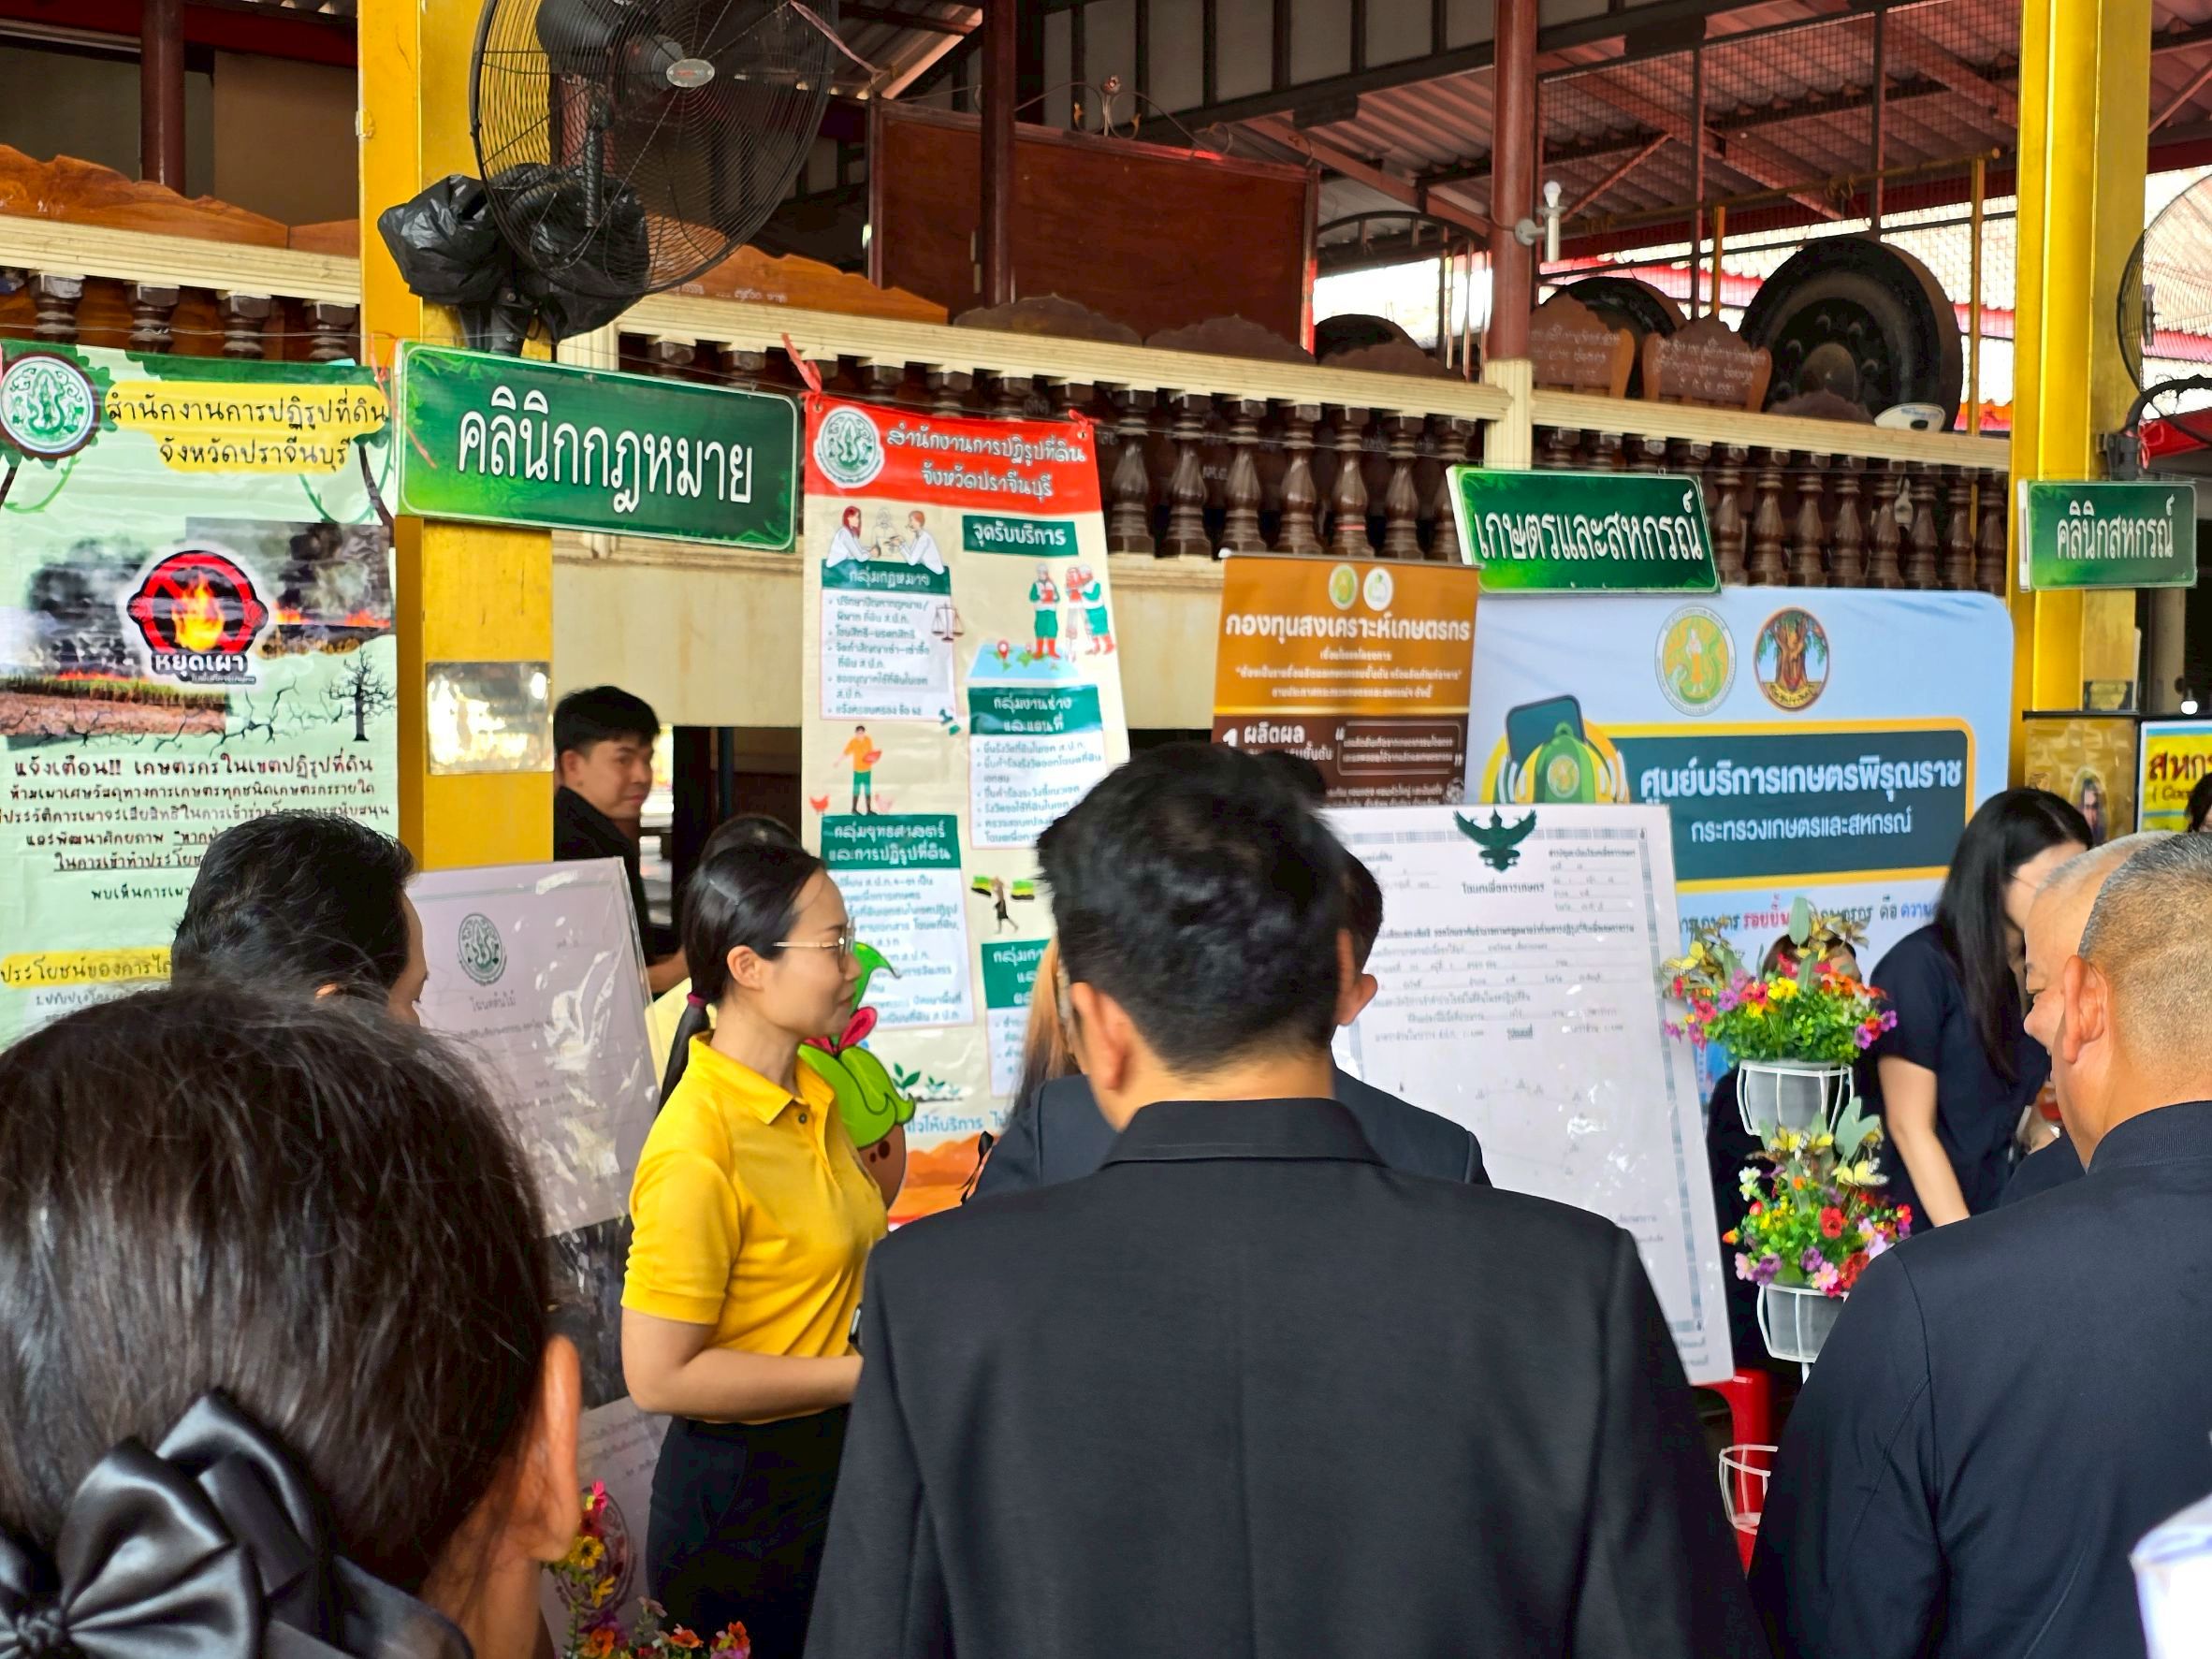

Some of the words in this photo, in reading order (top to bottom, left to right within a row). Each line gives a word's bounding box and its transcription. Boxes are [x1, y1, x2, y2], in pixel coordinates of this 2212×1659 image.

[107, 388, 387, 429] สำนักงานการปฏิรูปที่ดิน
[159, 437, 349, 471] จังหวัดปราจีนบุรี
[458, 385, 753, 514] คลินิกกฎหมาย
[887, 421, 1086, 466] สำนักงานการปฏิรูปที่ดิน
[922, 461, 1054, 502] จังหวัดปราจีนบุรี
[973, 519, 1067, 547] จุดรับบริการ
[1474, 488, 1705, 560] เกษตรและสหกรณ์
[2057, 494, 2176, 560] คลินิกสหกรณ์
[850, 565, 931, 589] กลุ่มกฎหมาย
[1226, 612, 1470, 644] กองทุนสงเคราะห์เกษตรกร
[154, 653, 245, 677] หยุดเผา
[1244, 721, 1305, 744] ผลิตผล
[15, 754, 122, 777] แจ้งเตือน!!
[1640, 755, 1961, 804] ศูนย์บริการเกษตรพิรุณราช
[1691, 806, 1912, 842] กระทรวงเกษตรและสหกรณ์
[1880, 895, 1898, 921] คือ
